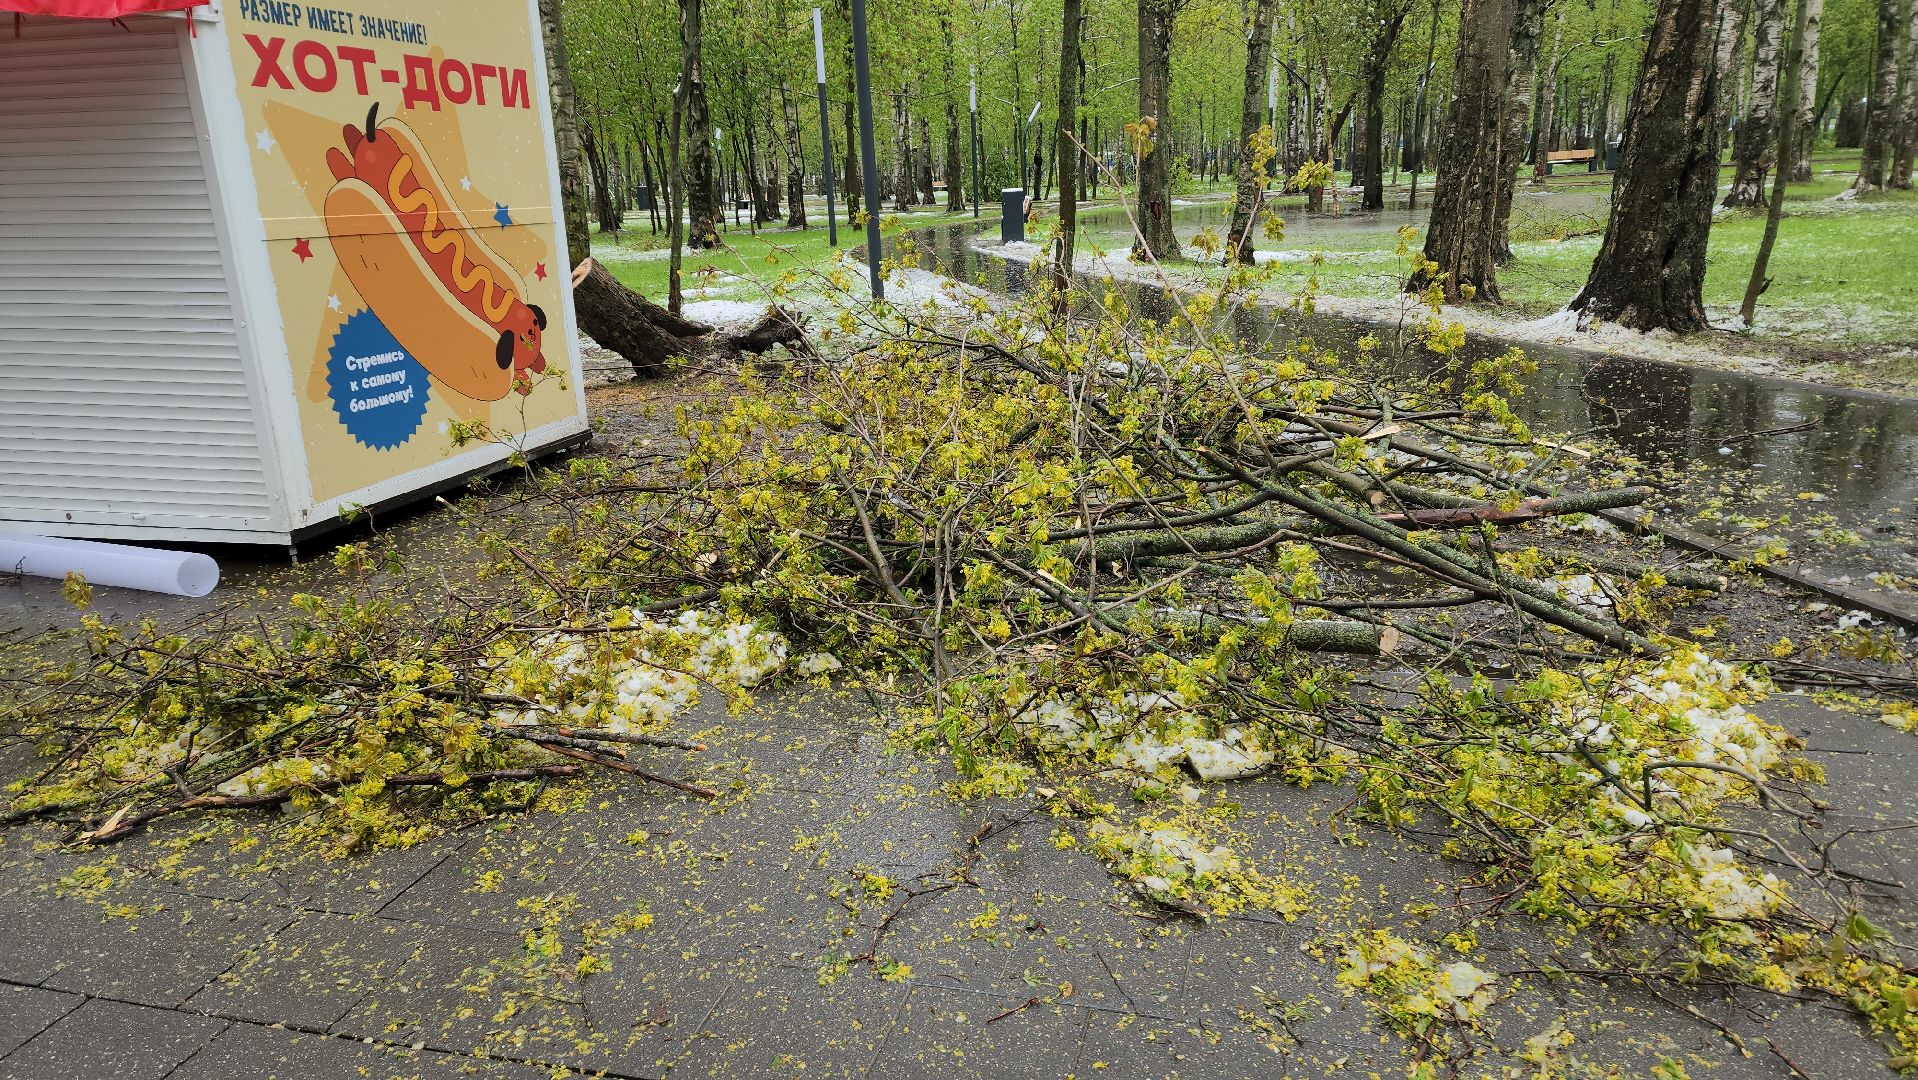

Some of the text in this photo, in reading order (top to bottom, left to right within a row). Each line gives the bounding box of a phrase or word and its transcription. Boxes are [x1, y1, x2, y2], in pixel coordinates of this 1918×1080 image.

[240, 0, 428, 45] РАЗМЕР ИМЕЕТ ЗНАЧЕНИЕ!
[242, 33, 531, 112] ХОТ-ДОГИ
[345, 350, 405, 372] Стремись
[349, 369, 406, 391] к самому
[349, 385, 414, 412] большому!
